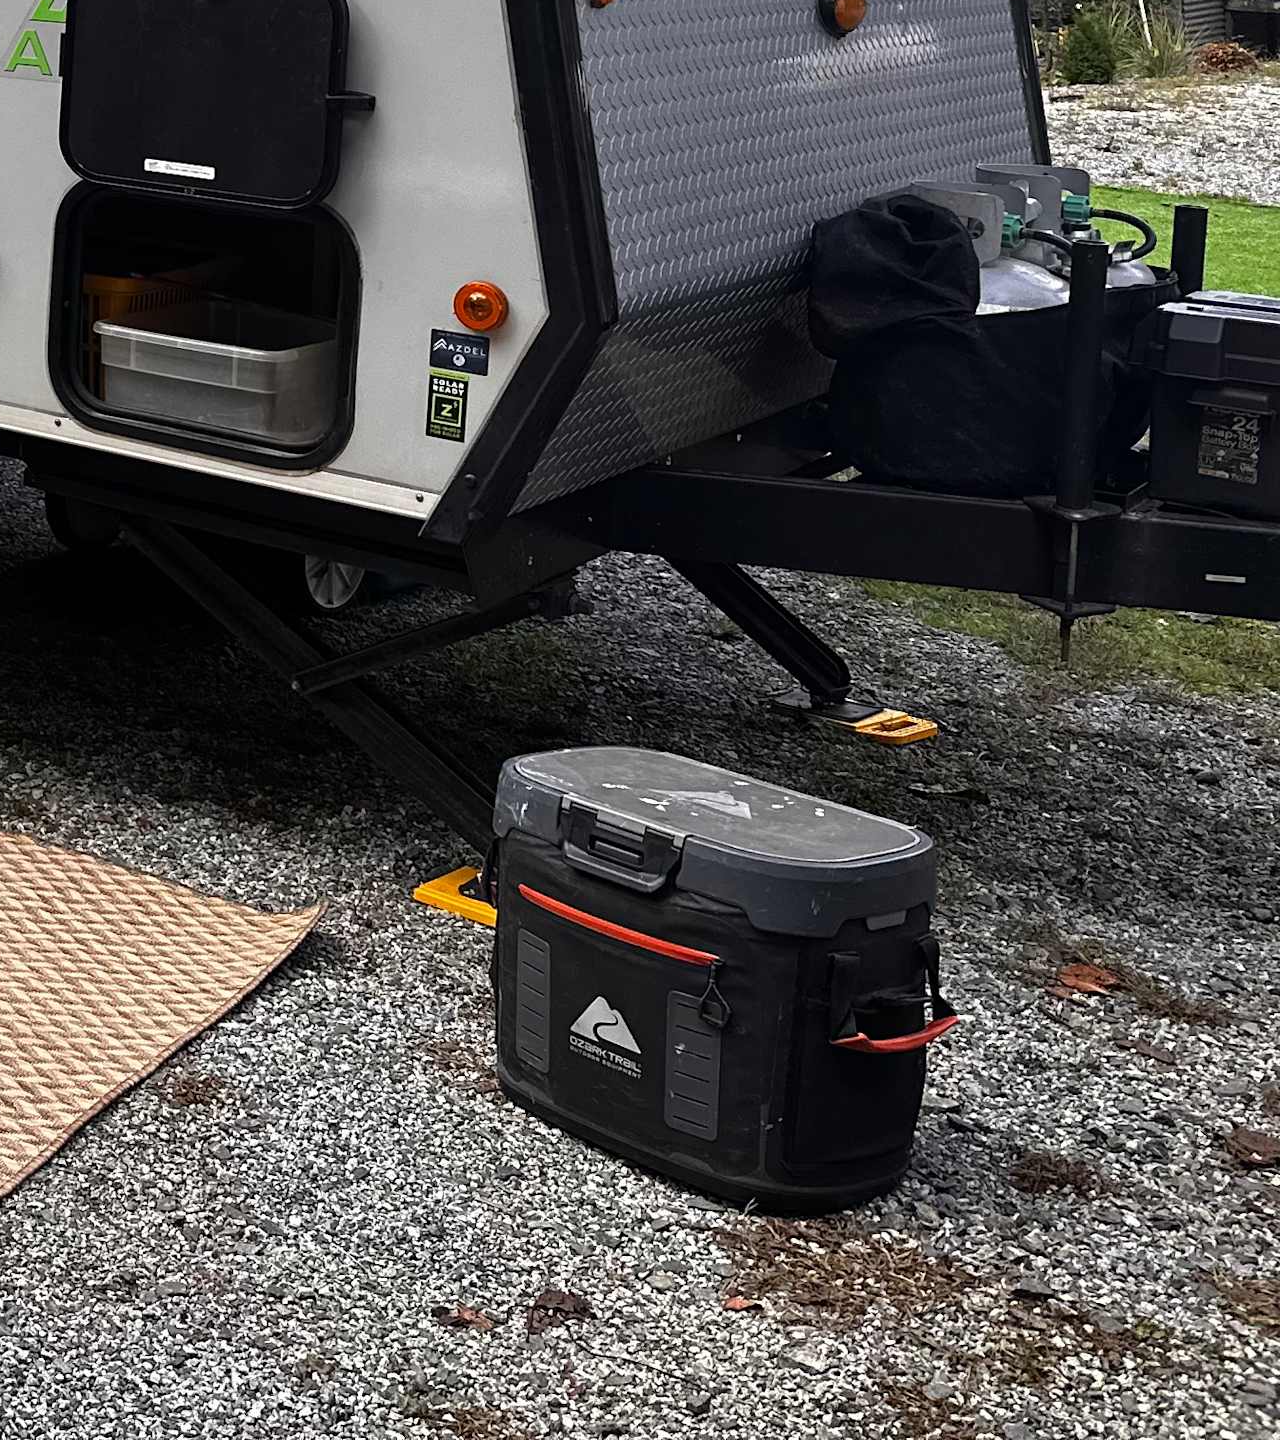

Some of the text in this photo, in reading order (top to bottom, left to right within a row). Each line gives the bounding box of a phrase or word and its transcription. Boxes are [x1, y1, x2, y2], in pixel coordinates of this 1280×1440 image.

[447, 343, 487, 357] AZDEL
[432, 378, 465, 390] SOLAR
[432, 385, 465, 397] READY
[1231, 416, 1260, 435] 24
